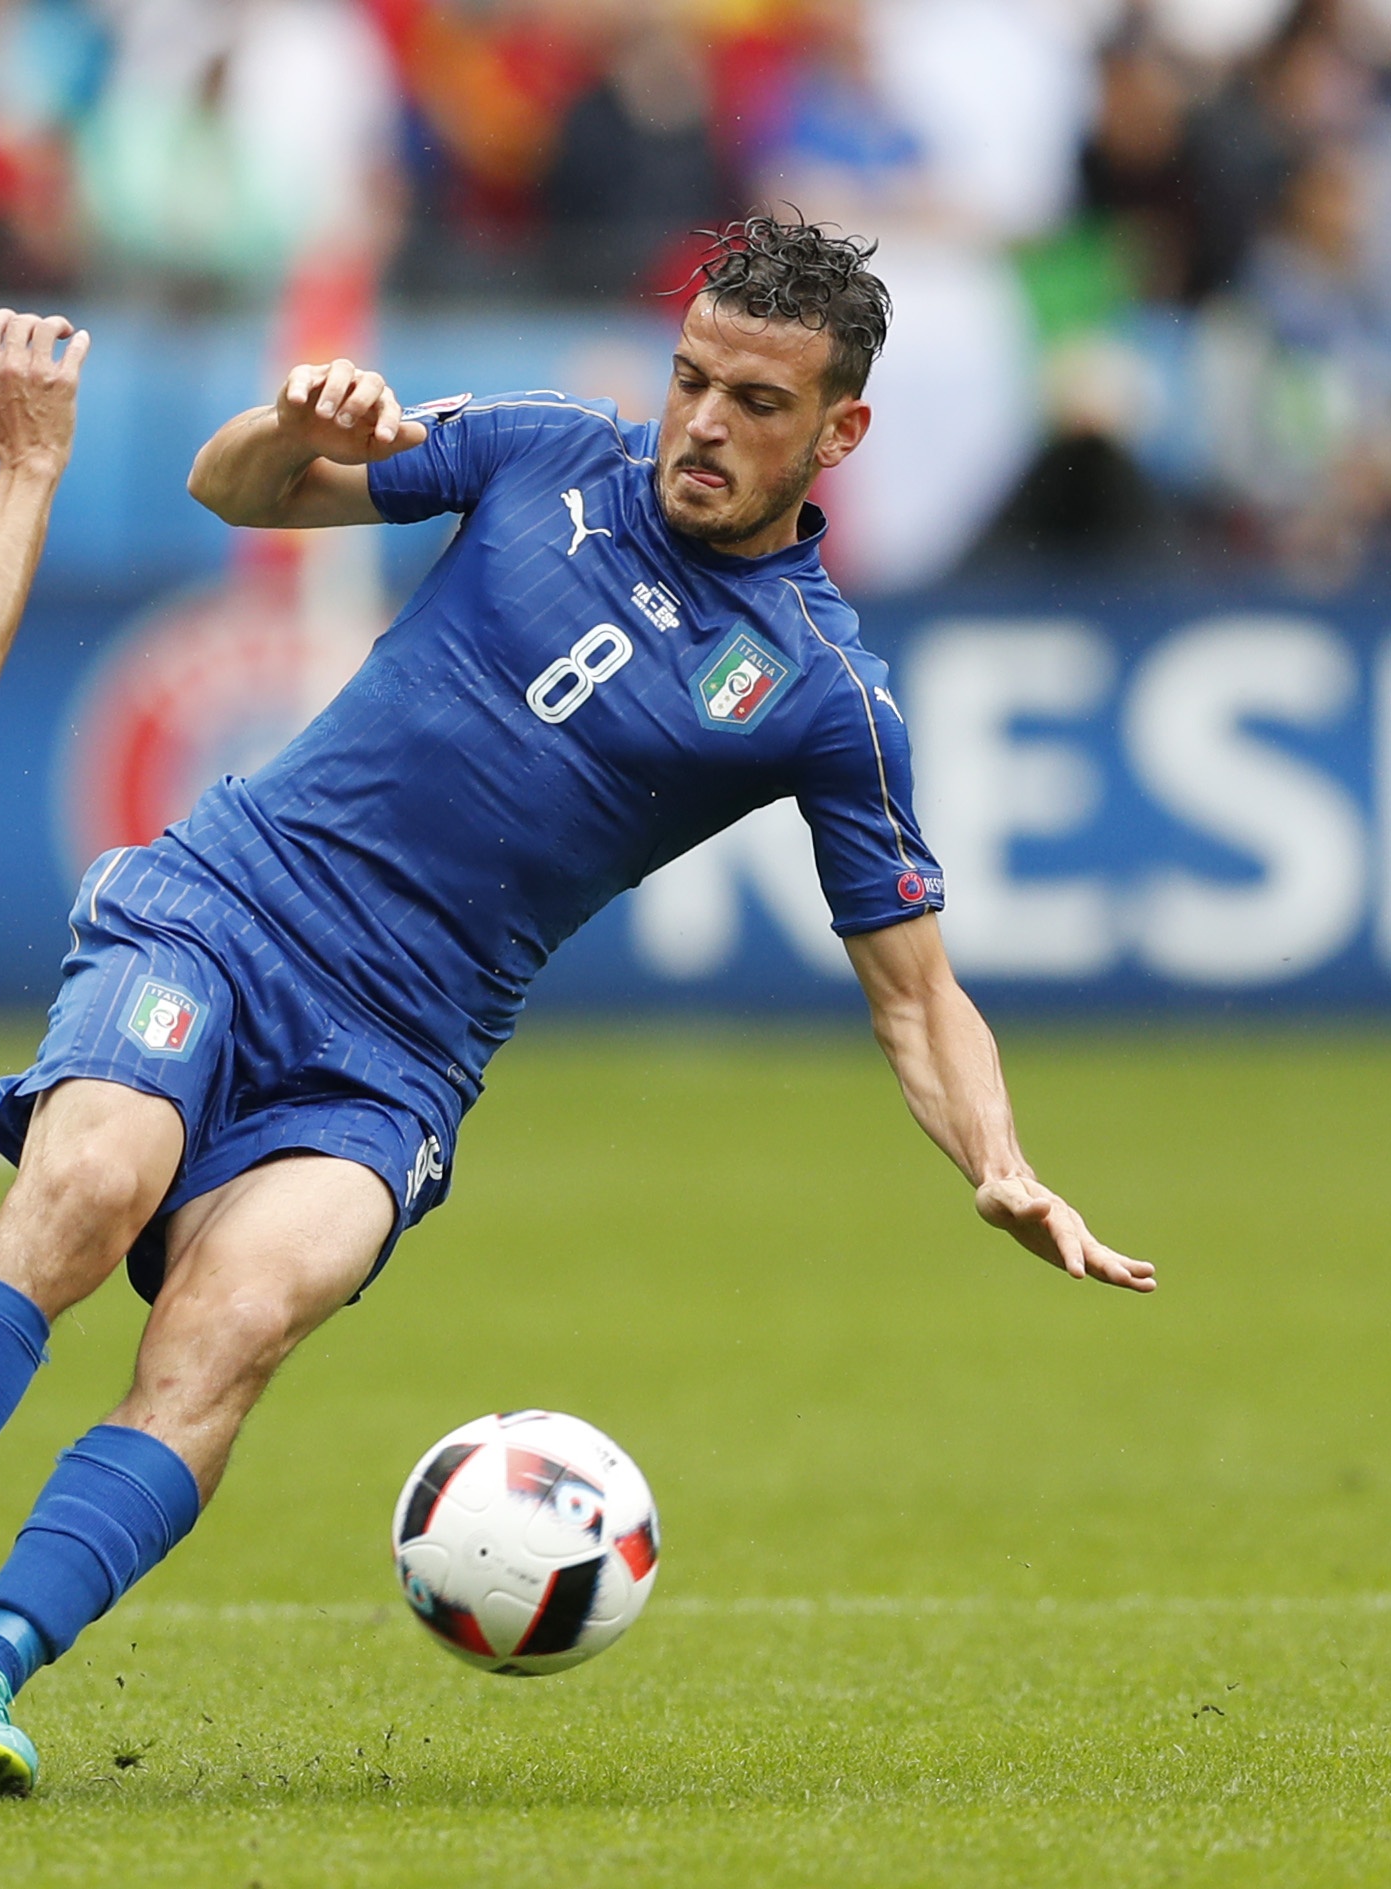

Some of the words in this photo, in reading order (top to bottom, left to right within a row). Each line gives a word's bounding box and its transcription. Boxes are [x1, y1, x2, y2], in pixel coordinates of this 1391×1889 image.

[632, 581, 653, 604] ITA
[654, 605, 681, 628] ESP
[525, 622, 635, 725] 8
[739, 643, 776, 677] ITALIA
[150, 987, 192, 1012] ITALIA
